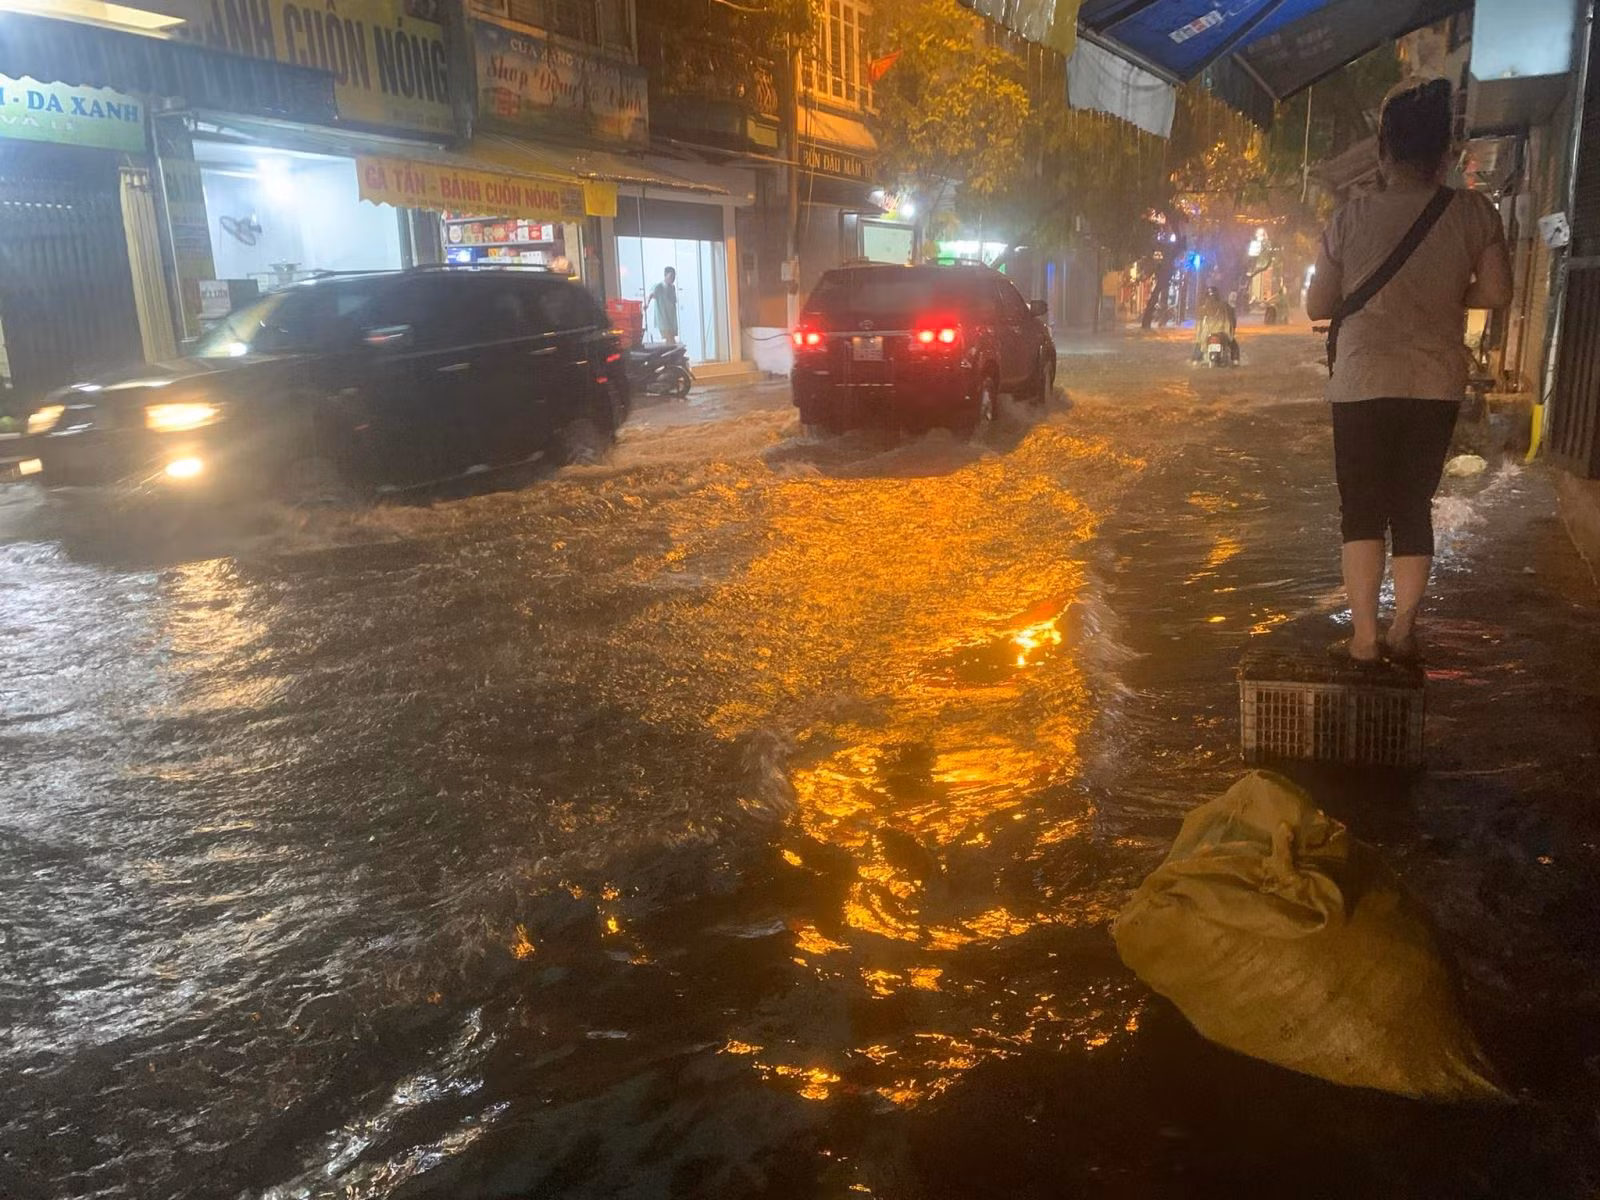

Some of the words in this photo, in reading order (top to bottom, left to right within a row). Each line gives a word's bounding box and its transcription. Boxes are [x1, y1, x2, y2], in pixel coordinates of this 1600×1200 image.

[487, 55, 528, 90] Shop
[27, 90, 64, 113] DA
[70, 95, 139, 122] XANH
[440, 172, 481, 201] BÁNH
[485, 177, 520, 206] CUỐN
[523, 183, 559, 210] NÓNG
